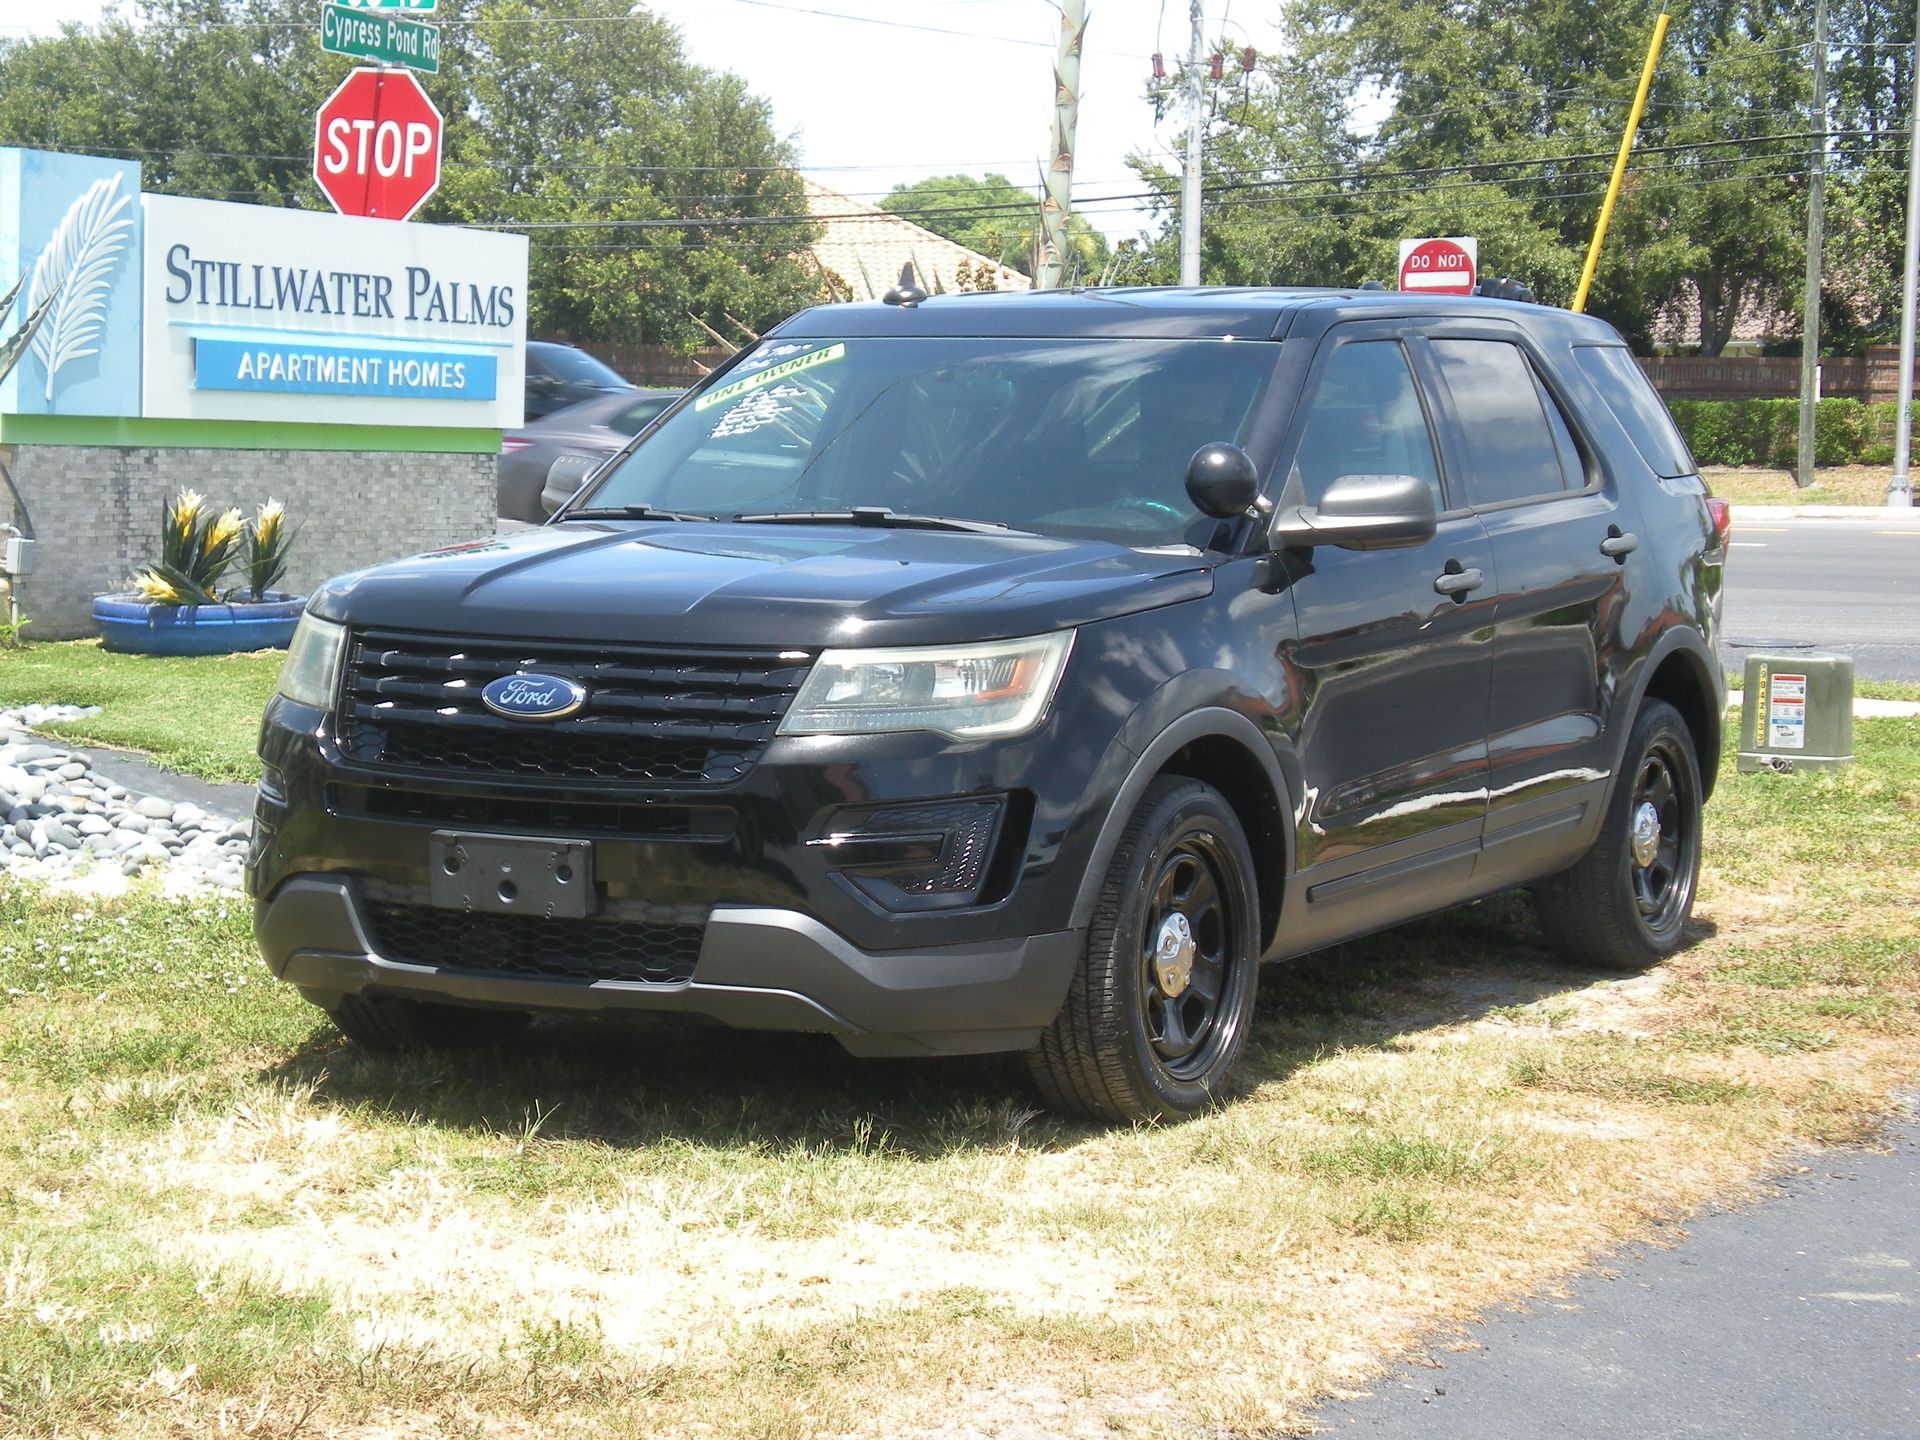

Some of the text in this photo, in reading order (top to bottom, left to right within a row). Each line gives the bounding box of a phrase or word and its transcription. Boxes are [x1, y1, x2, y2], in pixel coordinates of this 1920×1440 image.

[324, 9, 437, 60] Cypress Pond Rd
[323, 117, 433, 178] STOP
[165, 243, 514, 328] STILLWATER PALMS
[1411, 253, 1465, 269] DO NOT
[236, 350, 466, 390] APARTMENT HOMES
[706, 381, 748, 403] ONE
[755, 349, 832, 383] OWNER
[499, 679, 557, 706] Ford
